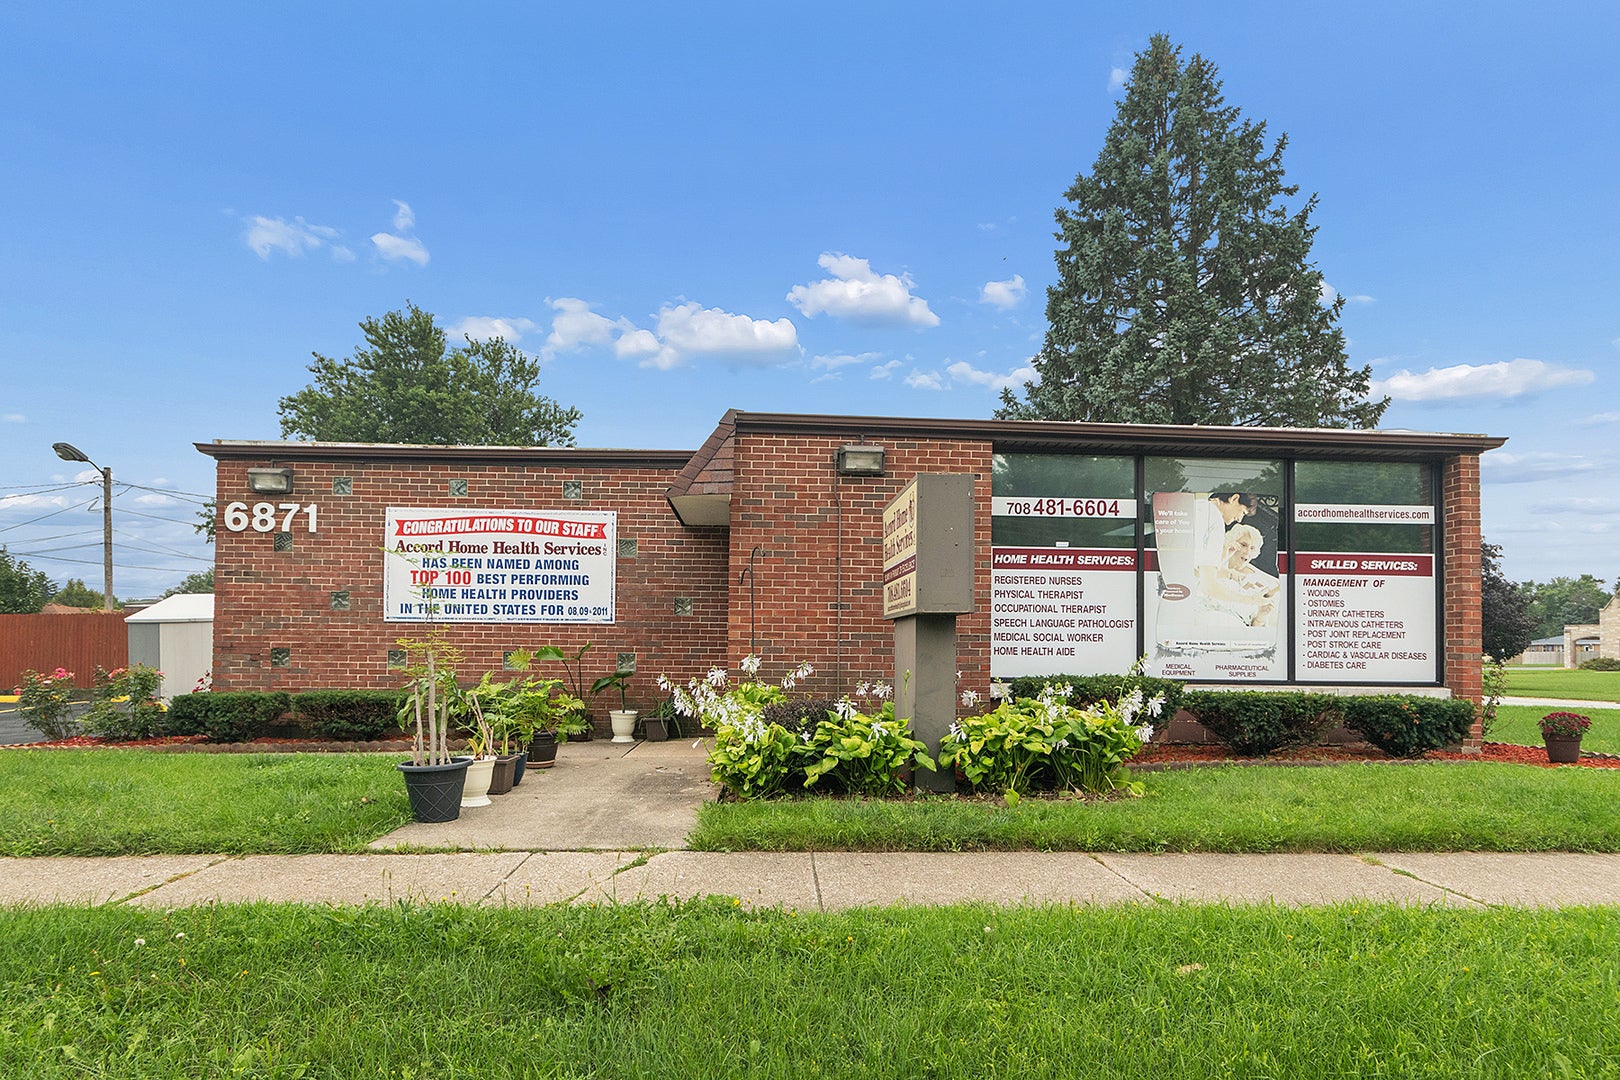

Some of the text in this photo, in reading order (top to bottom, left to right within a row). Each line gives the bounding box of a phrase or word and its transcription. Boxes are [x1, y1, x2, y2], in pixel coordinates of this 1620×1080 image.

[1007, 499, 1119, 516] 708 481-6604
[224, 501, 317, 532] 6871
[896, 508, 908, 529] Home
[1298, 508, 1429, 520] accordhomehealthservices.com
[403, 518, 514, 535] CONGRATULATIONS
[517, 518, 533, 534] TO
[535, 520, 559, 534] OUR
[896, 529, 913, 555] Services
[395, 540, 602, 556] Accord Home Health Services
[422, 558, 579, 570] HAS BEEN NAMED AMONG
[994, 554, 1135, 566] HOME HEALTH SERVICES:
[1311, 560, 1418, 571] SKILLED SERVICES:
[411, 570, 590, 586] TOP 100 BEST PERFORMING
[994, 576, 1082, 585] REGISTERED NURSES
[1303, 579, 1385, 587] MANAGEMENT OF
[422, 589, 579, 601] HOME HEALTH PROVIDERS
[994, 590, 1084, 599] PHYSICAL THERAPIST
[400, 603, 413, 614] IN
[444, 604, 489, 615] UNITED
[492, 604, 537, 615] STATES
[541, 604, 564, 615] FOR
[994, 604, 1106, 614] OCCUPATIONAL THERAPIST
[1308, 600, 1345, 608] OSTOMIES
[1308, 610, 1339, 618] URINARY
[994, 618, 1134, 628] SPEECH LANGUAGE PATHOLOGIST
[1308, 620, 1404, 629] INTRAVENOUS CATHETERS
[994, 633, 1104, 642] MEDICAL SOCIAL WORKER
[1352, 631, 1406, 639] REPLACEMENT
[994, 647, 1075, 656] HOME HEALTH AIDE
[1392, 652, 1427, 660] DISEASES
[1162, 669, 1195, 677] EQUIPMENT
